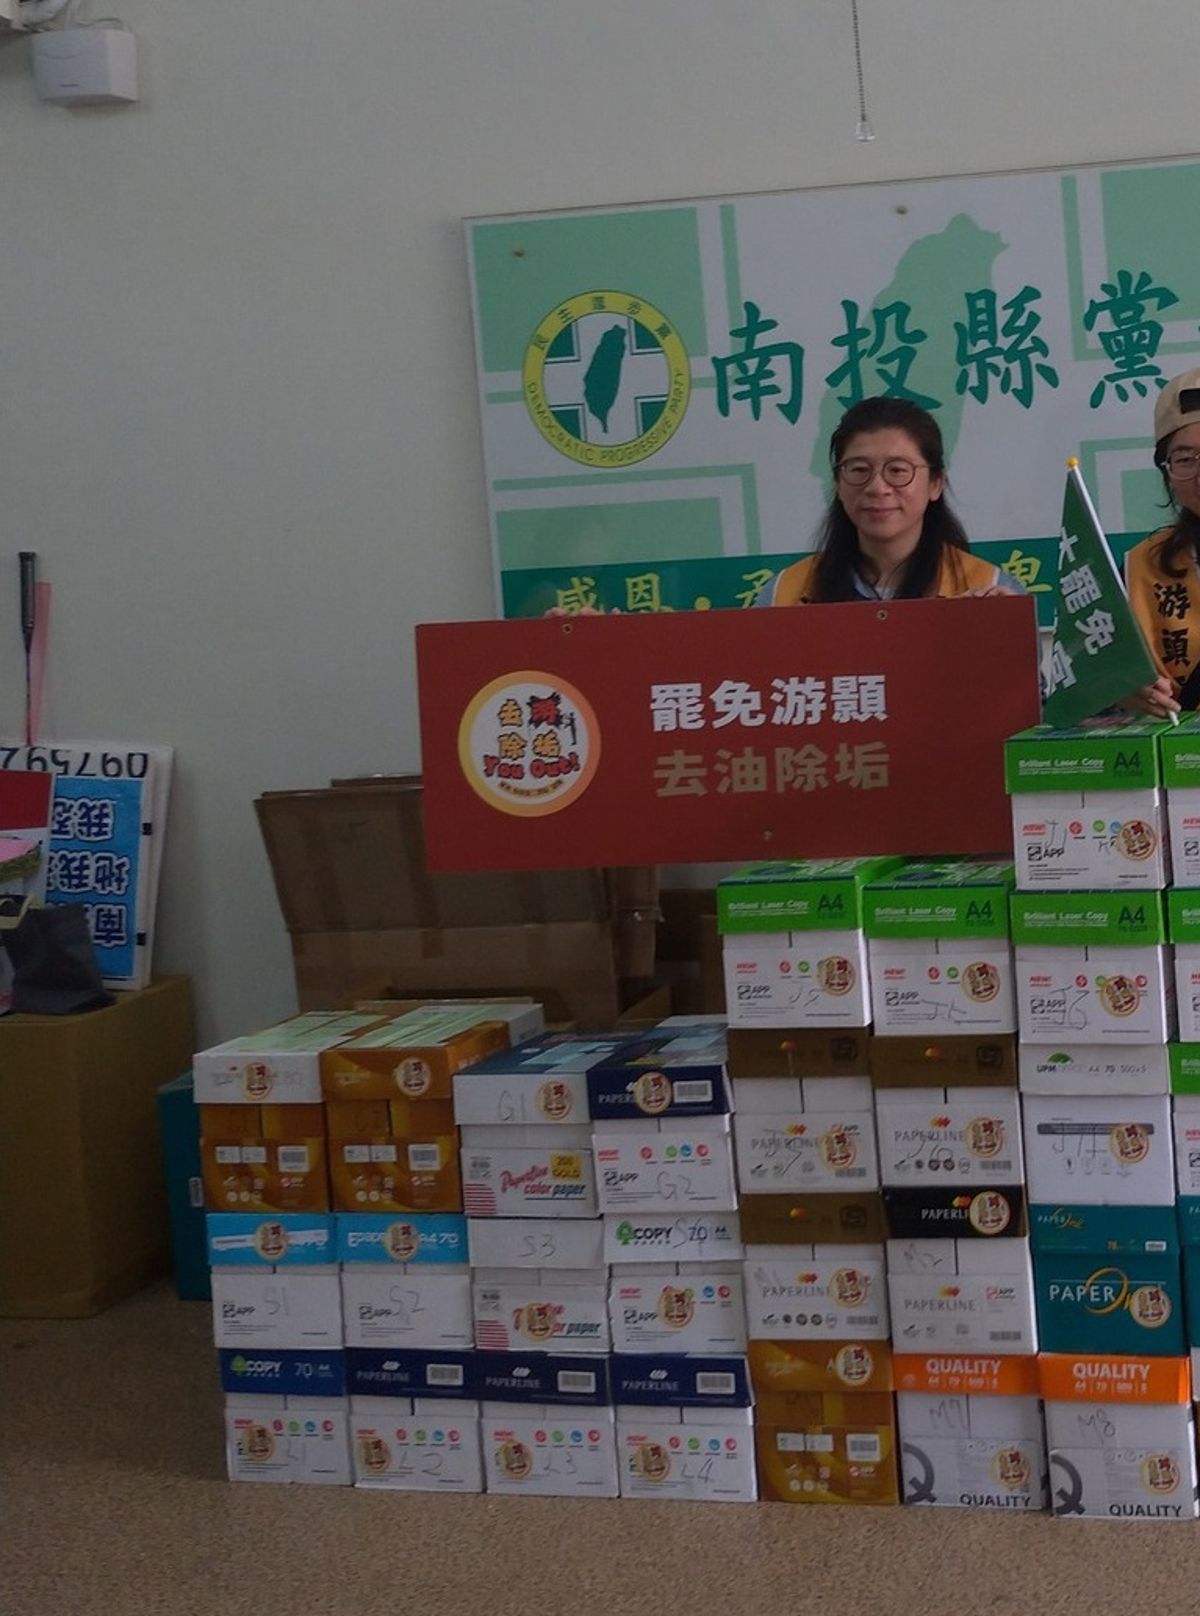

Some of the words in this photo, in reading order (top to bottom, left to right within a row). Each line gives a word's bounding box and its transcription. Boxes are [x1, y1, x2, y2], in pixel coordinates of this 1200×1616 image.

[650, 674, 889, 732] 罷免游顥
[1114, 751, 1141, 767] A4
[653, 741, 890, 798] 去油除垢
[818, 894, 843, 911] A4
[966, 901, 992, 917] A4
[1119, 906, 1145, 923] A4
[634, 1227, 672, 1239] COPY
[1050, 1284, 1115, 1301] PAPER
[246, 1361, 281, 1374] COPY
[926, 1359, 1001, 1375] QUALITY
[1073, 1363, 1150, 1379] QUALITY
[960, 1494, 1031, 1507] QUALITY
[1109, 1503, 1182, 1518] QUALITY
